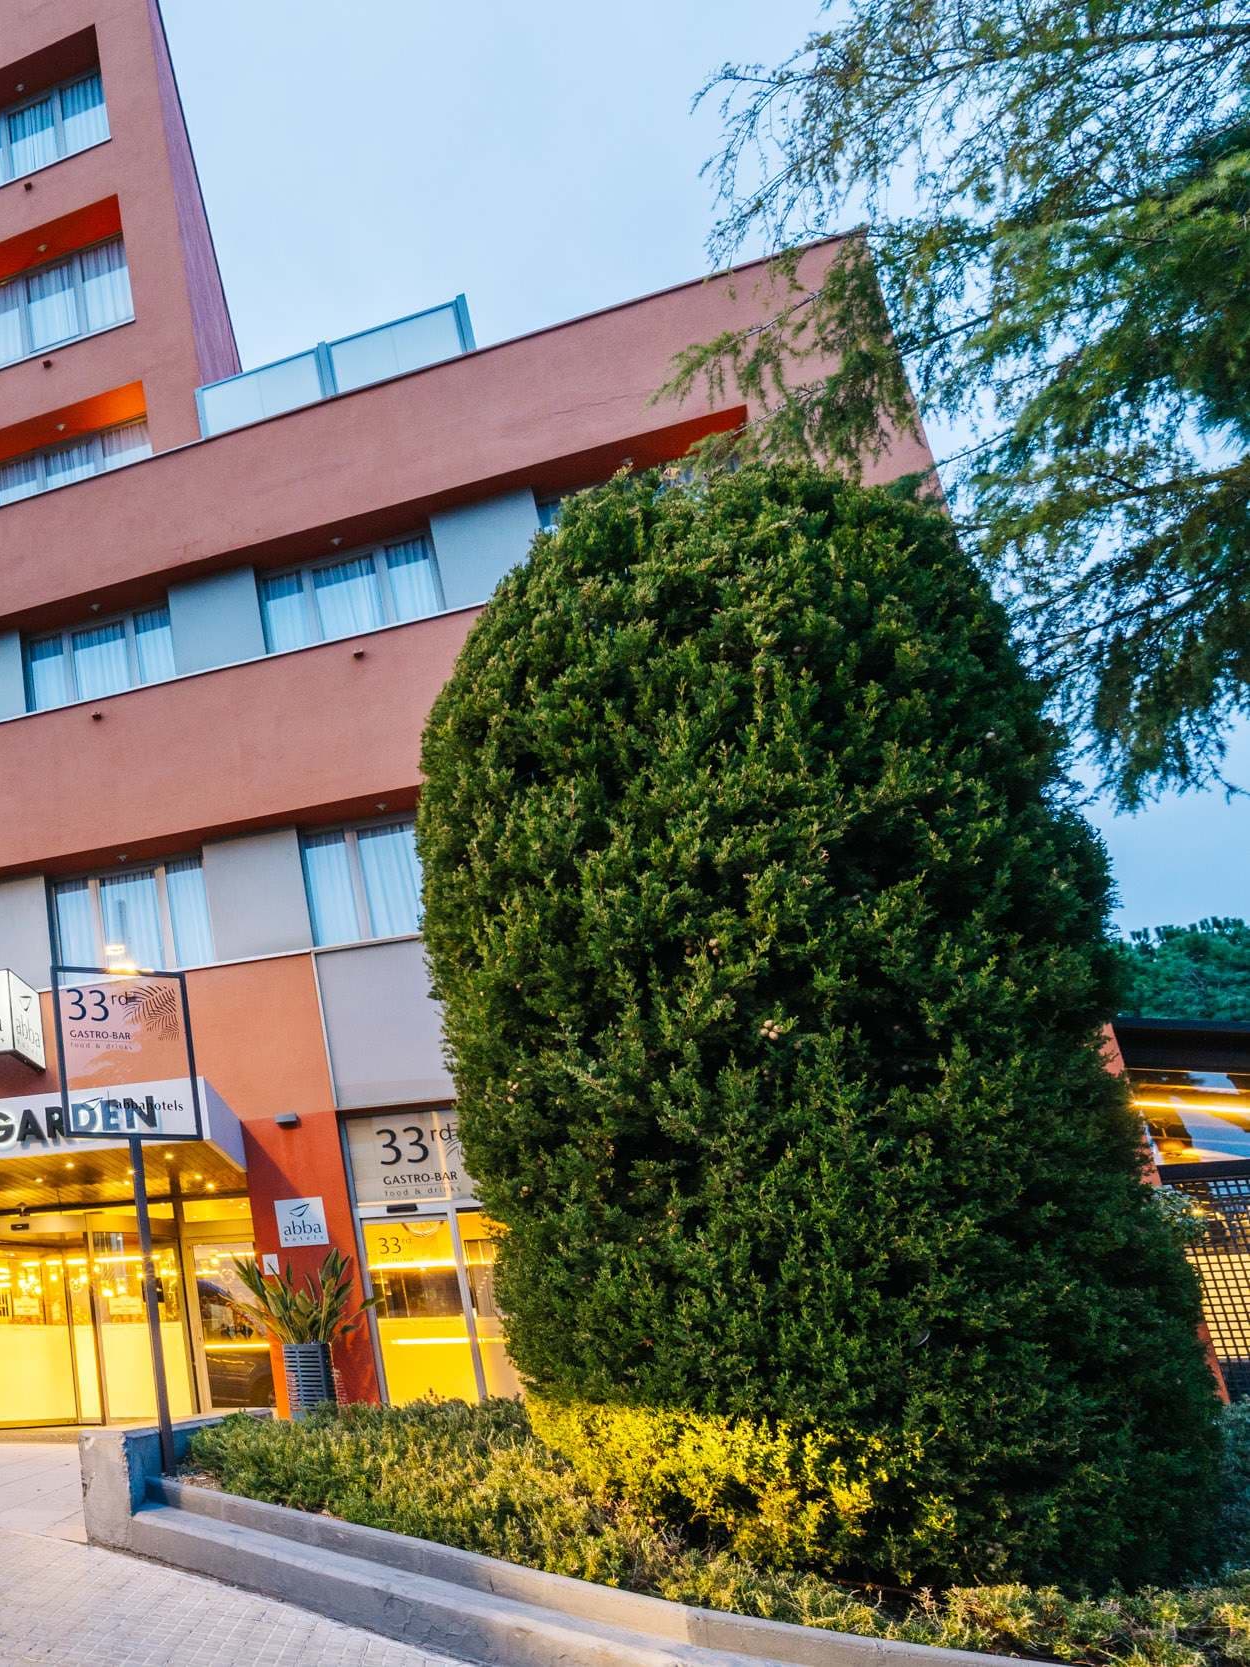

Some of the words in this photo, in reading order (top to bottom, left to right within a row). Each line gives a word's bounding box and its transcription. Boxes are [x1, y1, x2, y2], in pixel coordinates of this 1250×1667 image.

[69, 1029, 131, 1040] GASTRO-BAR
[376, 1123, 453, 1166] 33rd
[383, 1171, 458, 1186] GASTRO-BAR
[384, 1187, 409, 1197] food
[283, 1220, 322, 1236] abba
